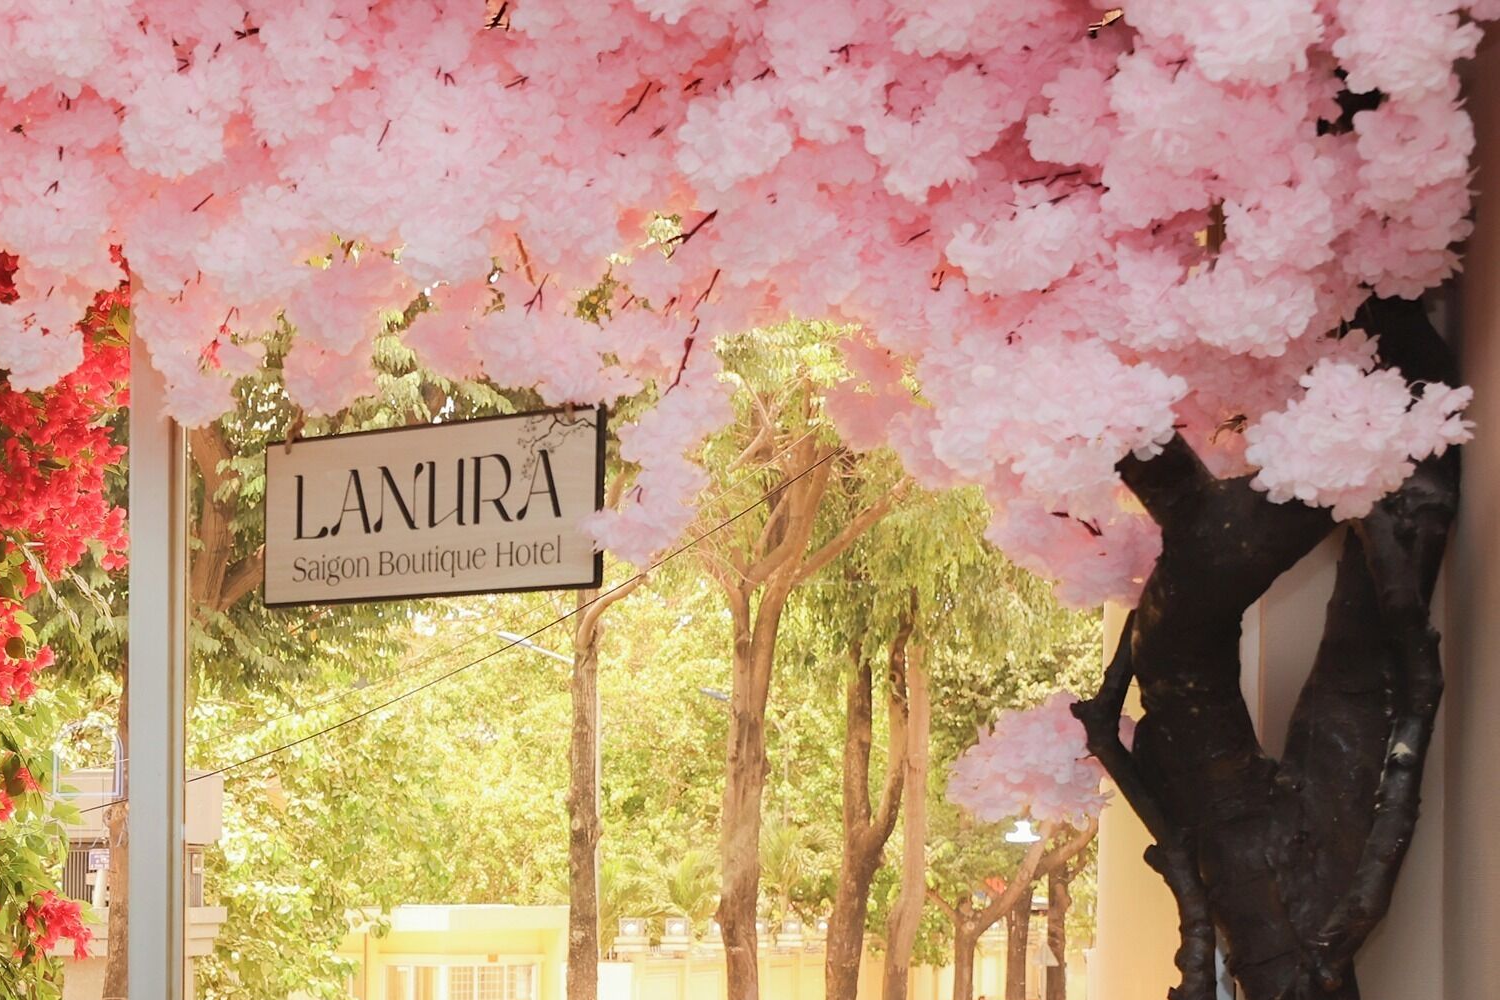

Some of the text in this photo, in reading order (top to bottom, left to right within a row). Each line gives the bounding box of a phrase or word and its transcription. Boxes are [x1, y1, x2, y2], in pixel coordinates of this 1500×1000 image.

[294, 450, 561, 540] LANURA
[292, 535, 561, 586] Saigon Boutique Hotel
